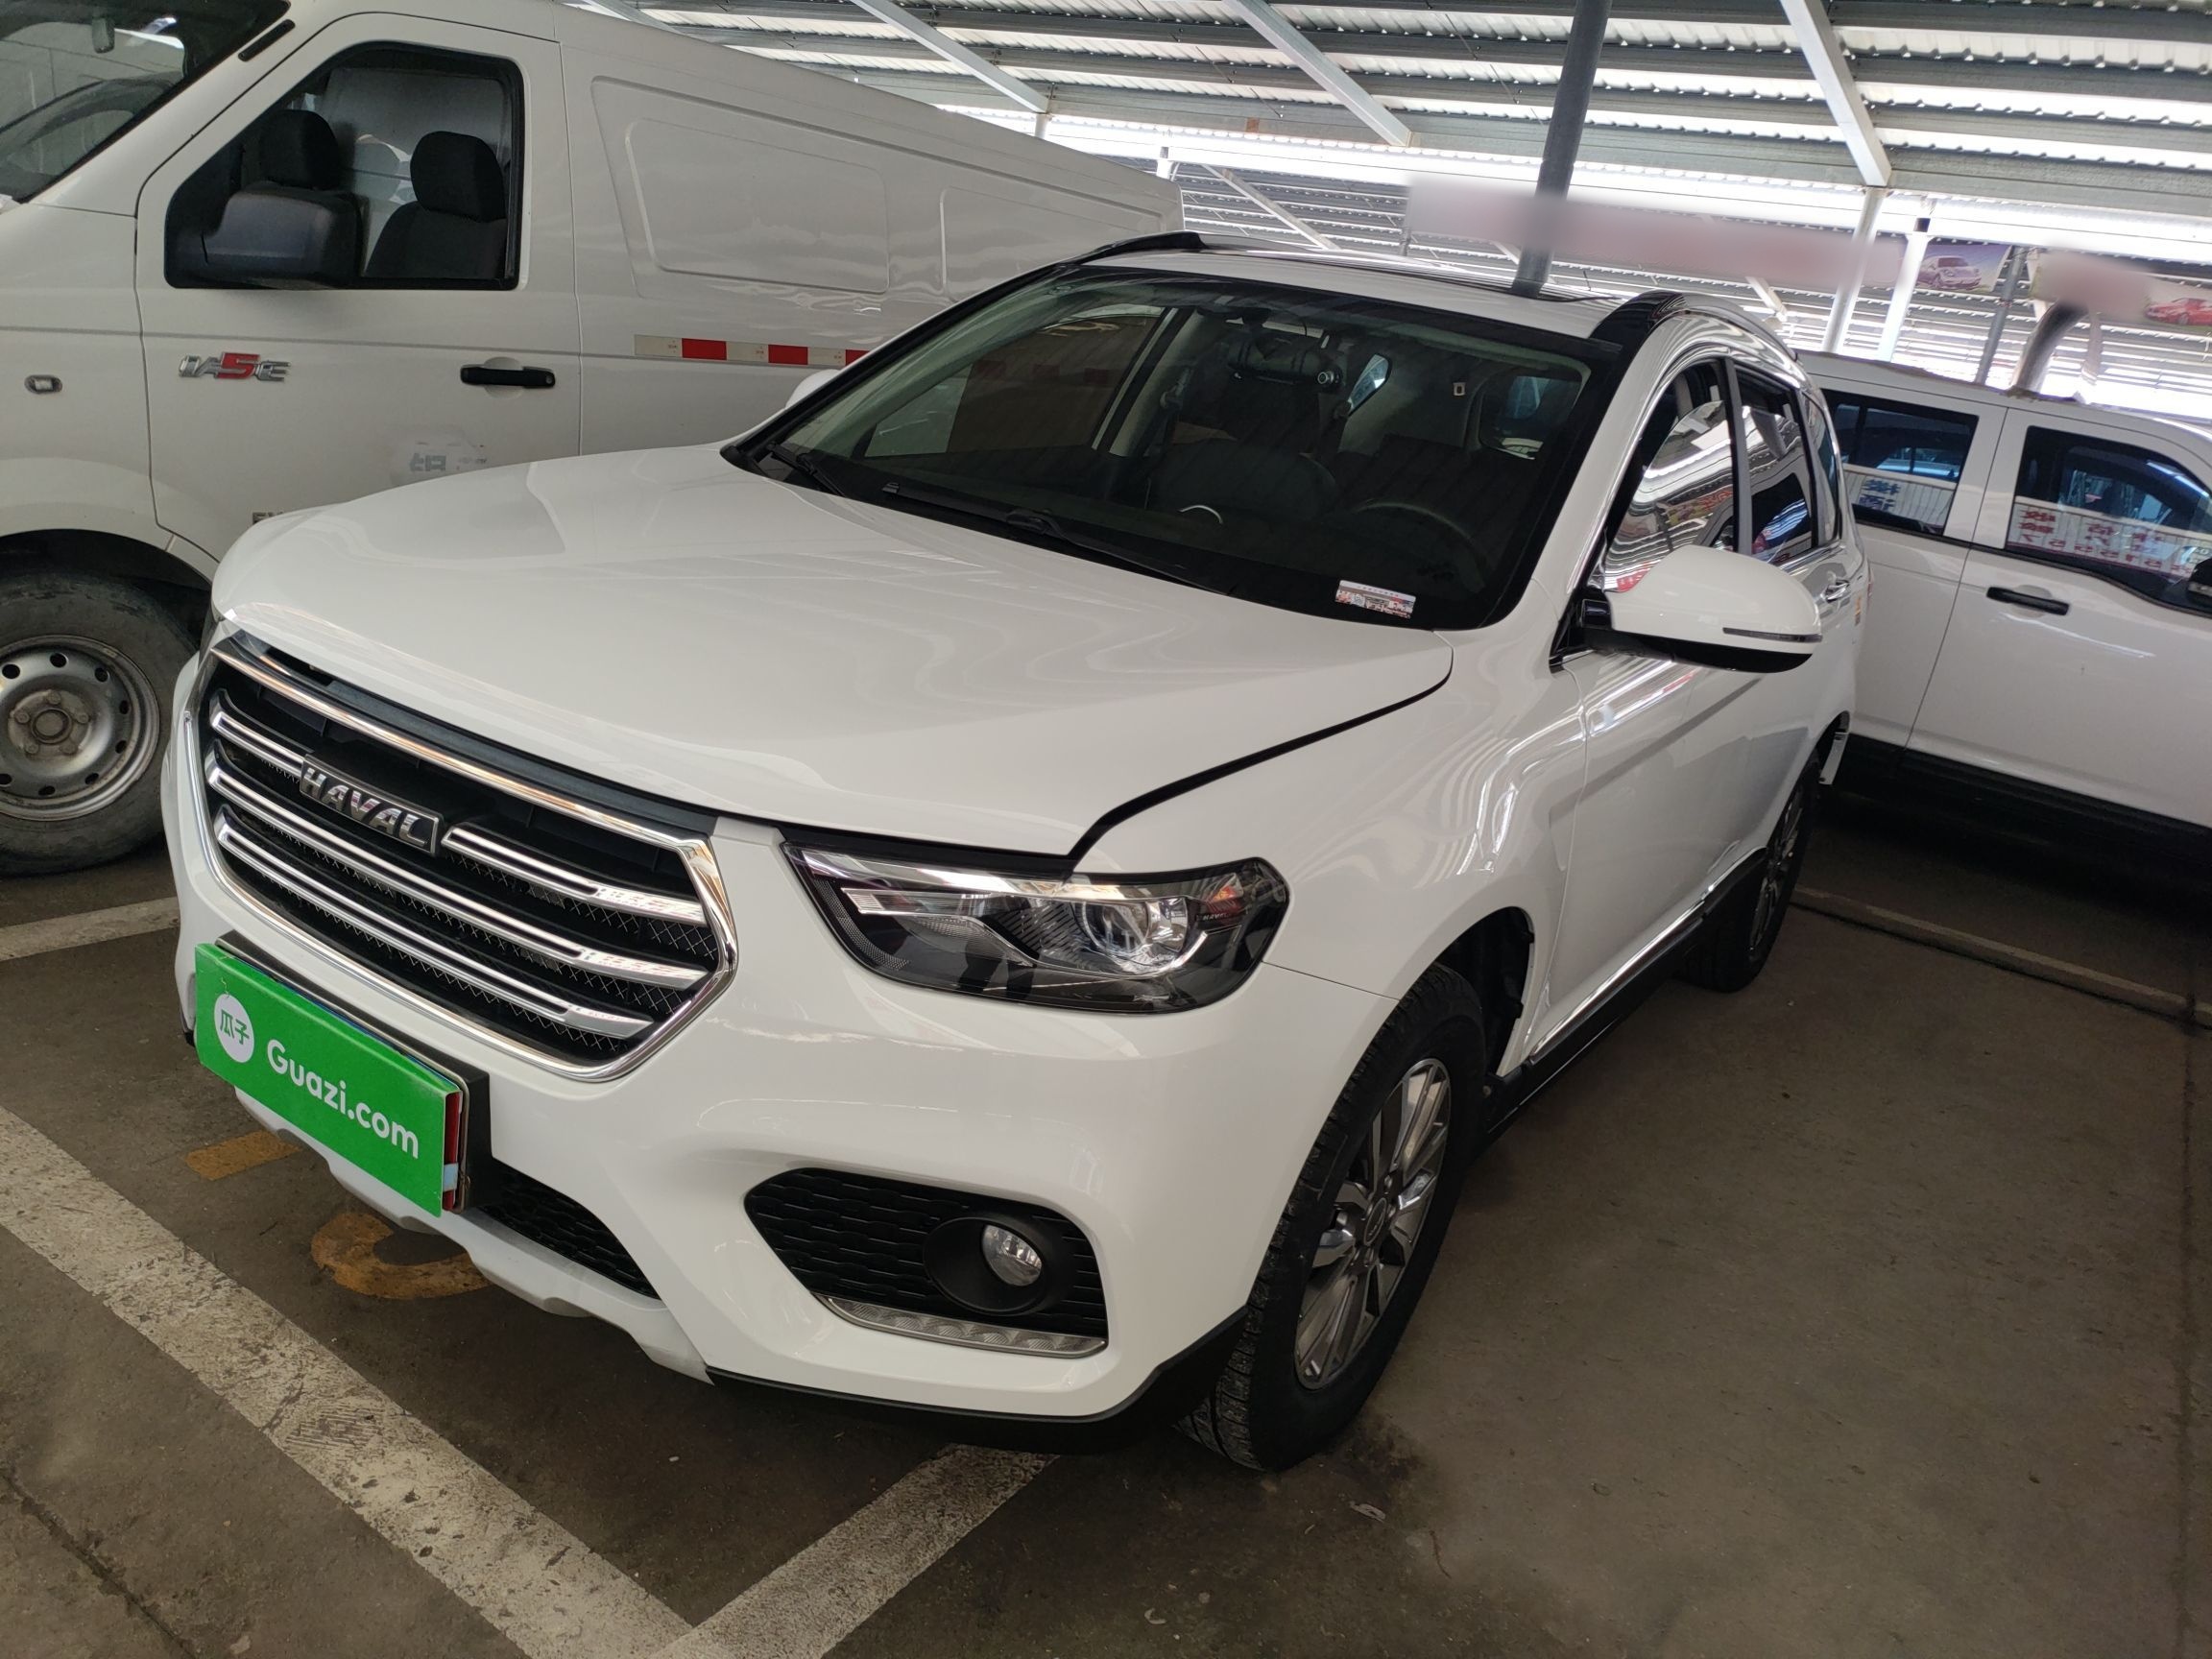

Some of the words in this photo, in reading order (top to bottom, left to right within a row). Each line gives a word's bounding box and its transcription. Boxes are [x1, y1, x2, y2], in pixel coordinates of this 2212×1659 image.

[301, 767, 427, 847] HAVAL
[219, 1009, 251, 1045] 瓜子
[266, 1038, 420, 1160] Guazi.com
